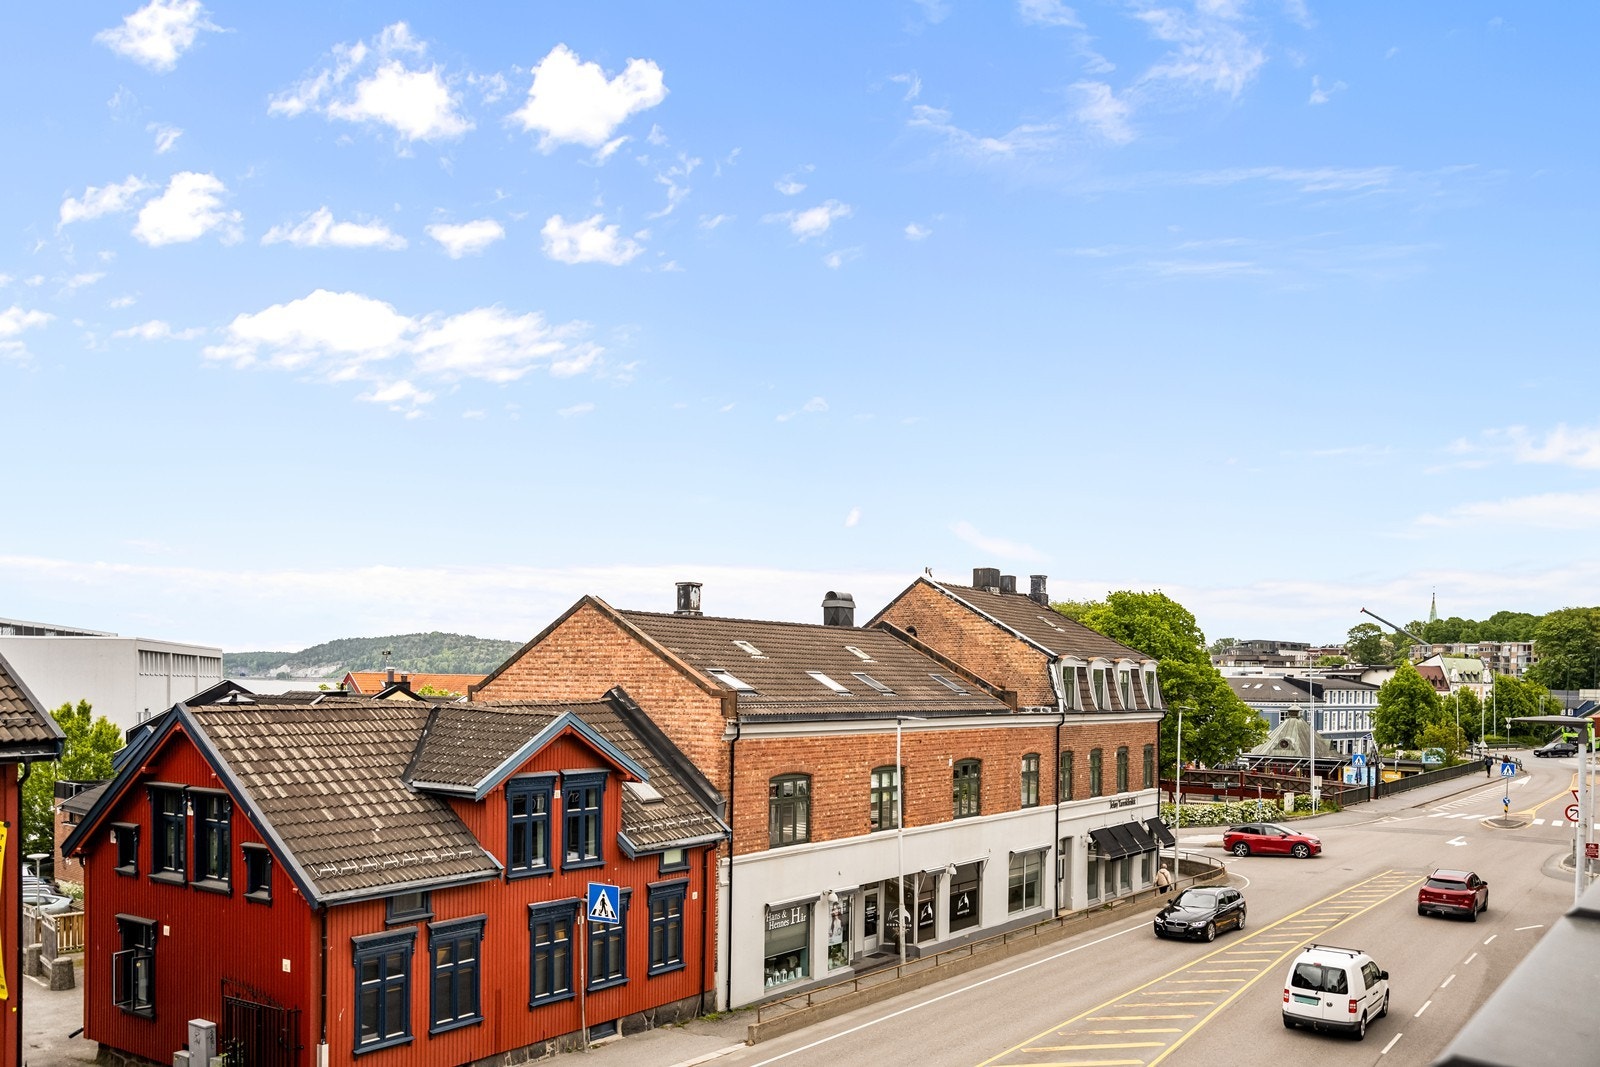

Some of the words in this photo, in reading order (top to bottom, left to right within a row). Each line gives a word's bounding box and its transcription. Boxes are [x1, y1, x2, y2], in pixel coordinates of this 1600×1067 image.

[766, 912, 781, 923] Hans
[781, 909, 787, 919] &
[790, 906, 807, 925] Hår
[768, 918, 790, 931] Hennes
